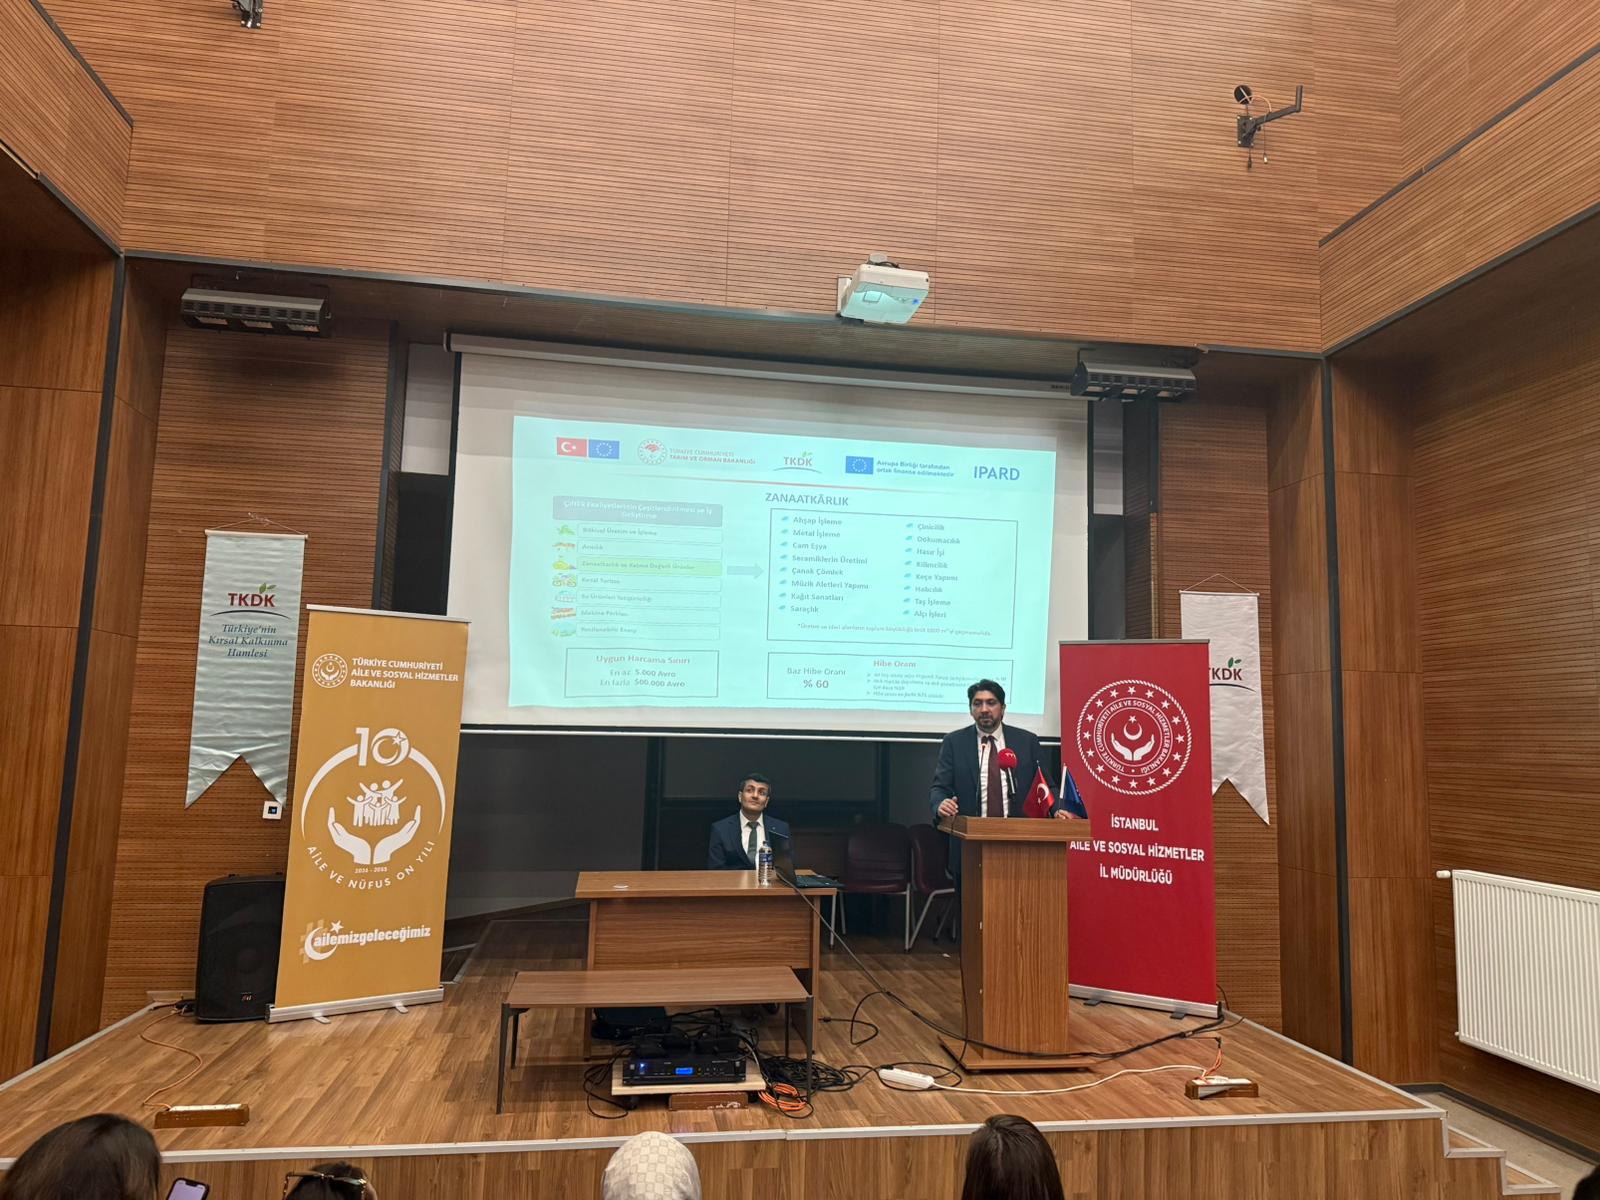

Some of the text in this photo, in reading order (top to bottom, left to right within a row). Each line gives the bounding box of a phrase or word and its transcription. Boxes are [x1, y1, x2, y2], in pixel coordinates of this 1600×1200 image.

[783, 455, 812, 467] TKDK
[973, 465, 1020, 481] IPARD
[793, 516, 842, 526] Ahşap İşleme
[793, 528, 841, 539] Metal İşleme
[793, 542, 827, 551] Cam Eşya
[792, 554, 838, 563] Seramiklerin
[791, 567, 844, 577] Çanak Çömlek
[915, 573, 932, 582] Keçe
[791, 579, 814, 588] Müzik
[228, 593, 276, 607] TKDK
[914, 598, 926, 606] Taş
[790, 605, 819, 614] Saraçlık
[914, 610, 928, 618] Alçı
[222, 624, 277, 635] Türkiye'nin
[208, 635, 288, 647] Kırsal Kalkınma
[227, 648, 268, 658] Hamlesi
[352, 656, 444, 671] TÜRKİYE CUMHURİYETİ
[596, 655, 691, 664] Uygun Harcama Sınırı
[873, 660, 892, 668] Hibe
[351, 668, 459, 682] AİLE VE SOSYAL HİZMETLER
[787, 667, 847, 676] Baz Hibe Oranı
[1209, 667, 1243, 681] KDK
[350, 677, 396, 689] BAKANLIĞI
[815, 680, 830, 689] 60
[1123, 699, 1132, 707] VE
[1132, 699, 1156, 714] SOSYAL
[1111, 813, 1159, 831] İSTANBUL
[1093, 840, 1106, 852] VE
[1108, 841, 1146, 856] SOSYAL
[1148, 843, 1205, 862] HİZMETLER
[307, 840, 436, 890] AİLE VE NÜFUS ON YILI
[1099, 863, 1173, 884] İL MÜDÜRLÜĞÜ
